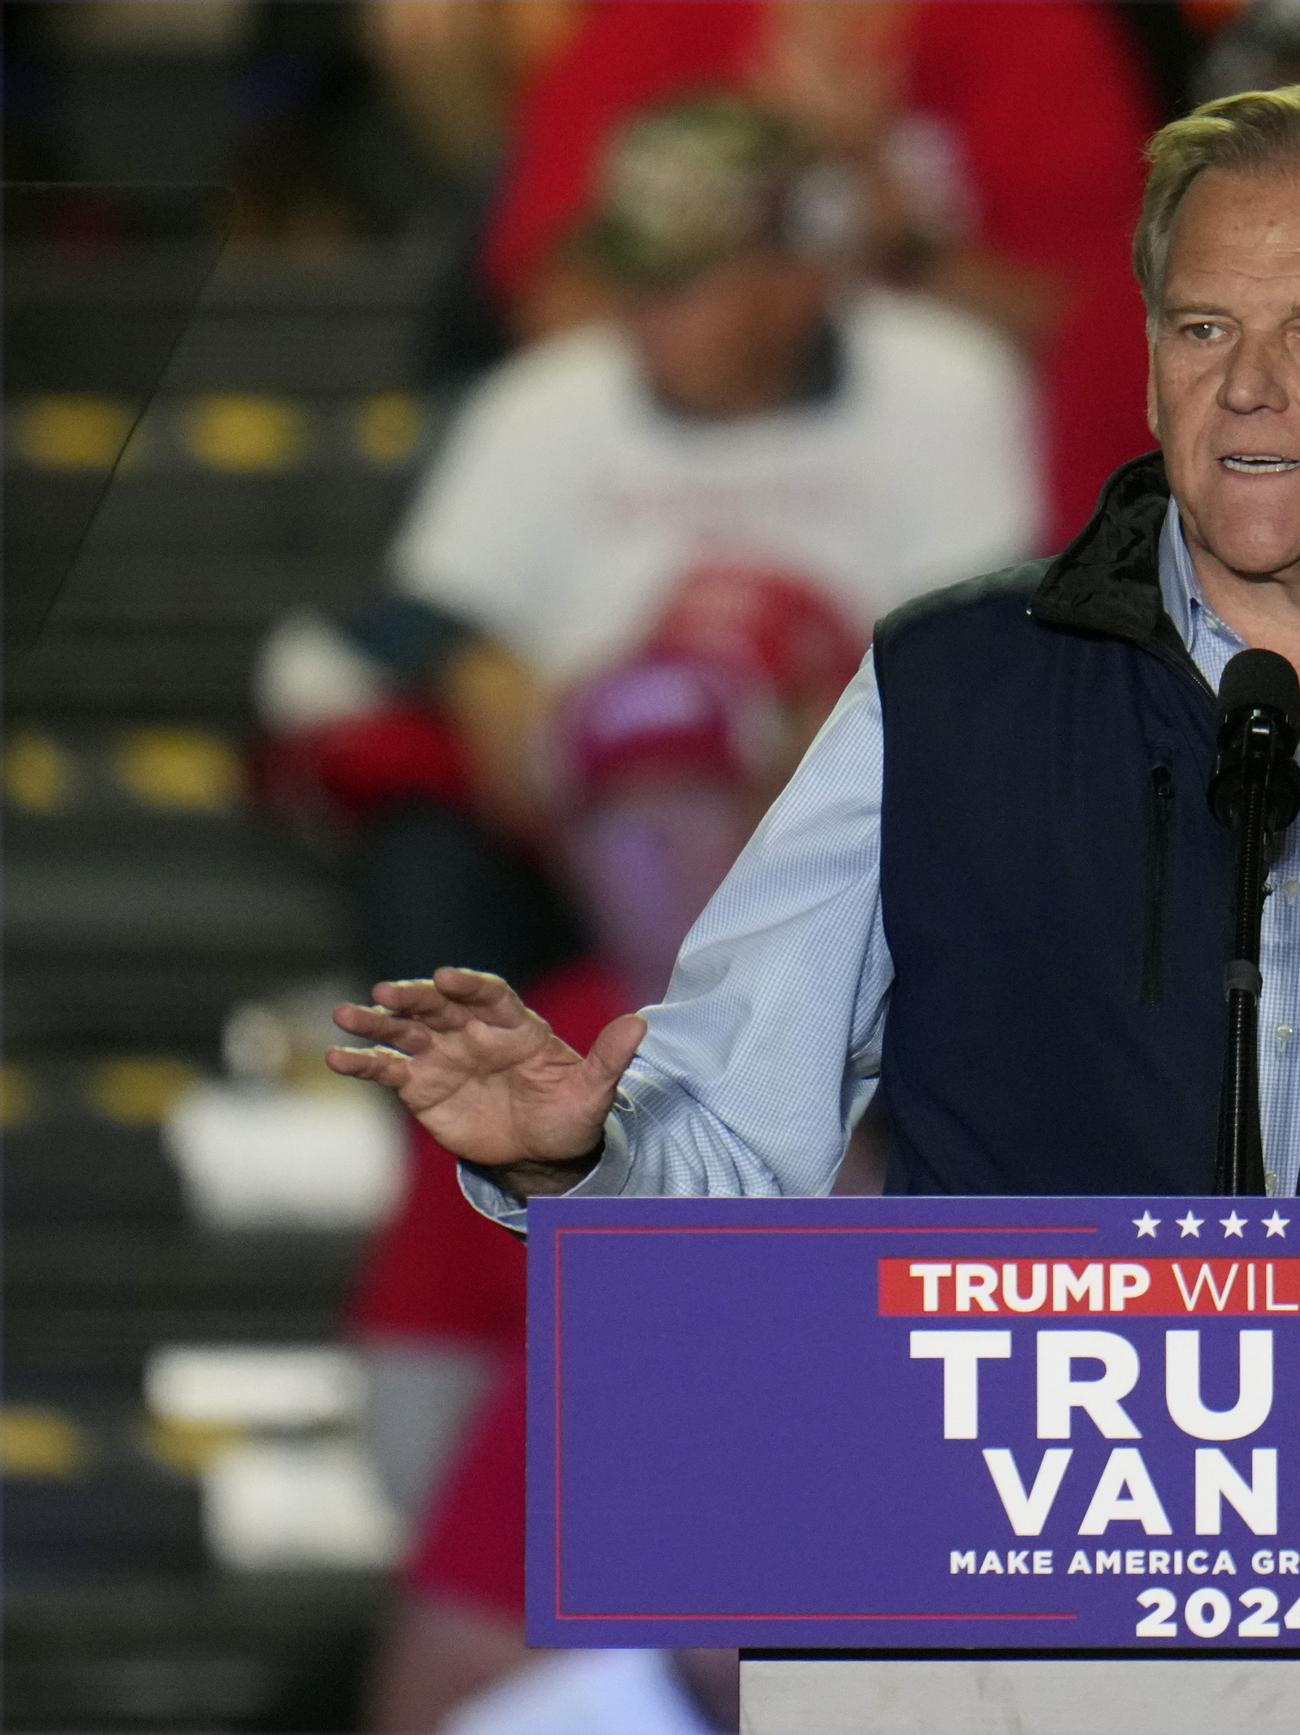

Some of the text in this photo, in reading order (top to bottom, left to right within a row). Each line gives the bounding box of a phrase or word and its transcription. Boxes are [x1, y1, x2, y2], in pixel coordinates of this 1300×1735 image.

[909, 1263, 1151, 1313] TRUMP
[950, 1550, 1054, 1575] MAKE
[1067, 1549, 1237, 1575] AMERICA
